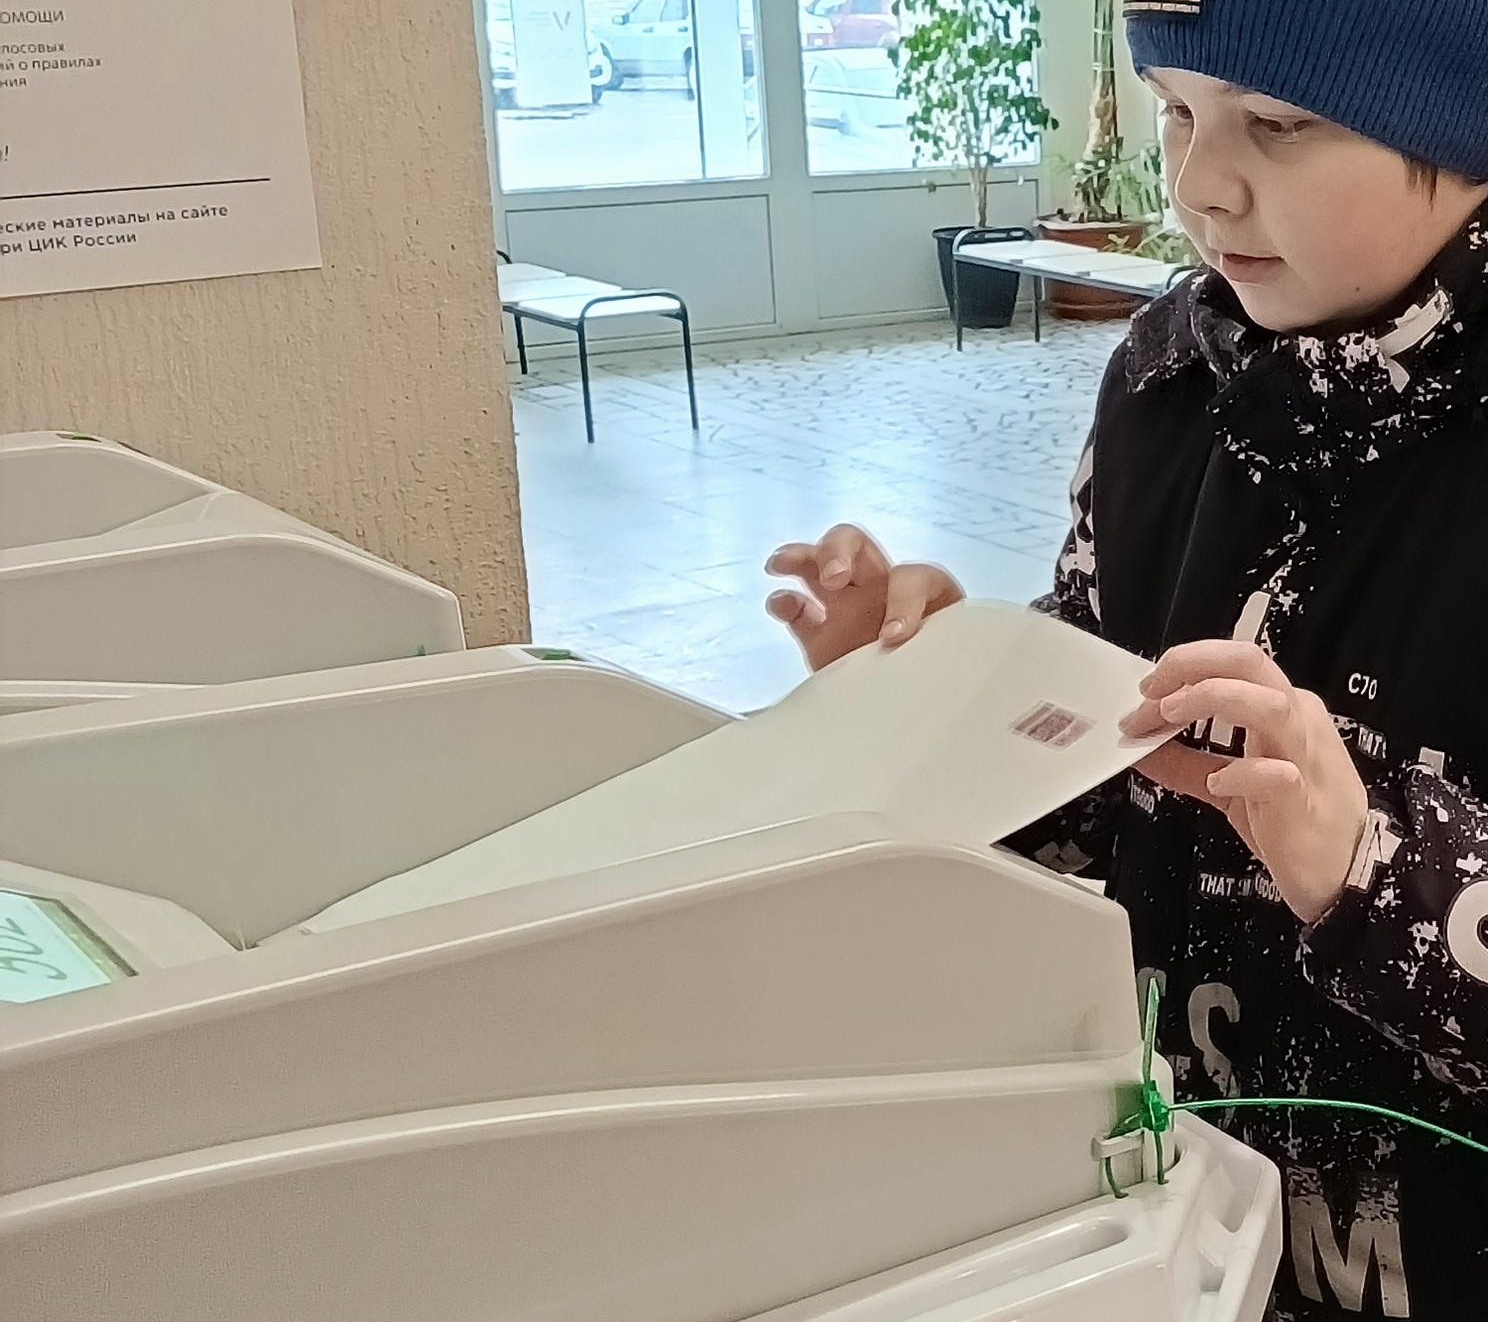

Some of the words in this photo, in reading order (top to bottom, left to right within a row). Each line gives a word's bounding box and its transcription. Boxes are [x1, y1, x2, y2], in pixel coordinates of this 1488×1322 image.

[19, 61, 28, 71] о
[32, 58, 101, 72] правилах
[53, 212, 151, 229] материалы
[156, 209, 176, 222] на
[181, 205, 229, 220] сайте
[28, 236, 68, 254] ЦИК
[73, 232, 137, 248] России
[1200, 872, 1235, 897] THAT
